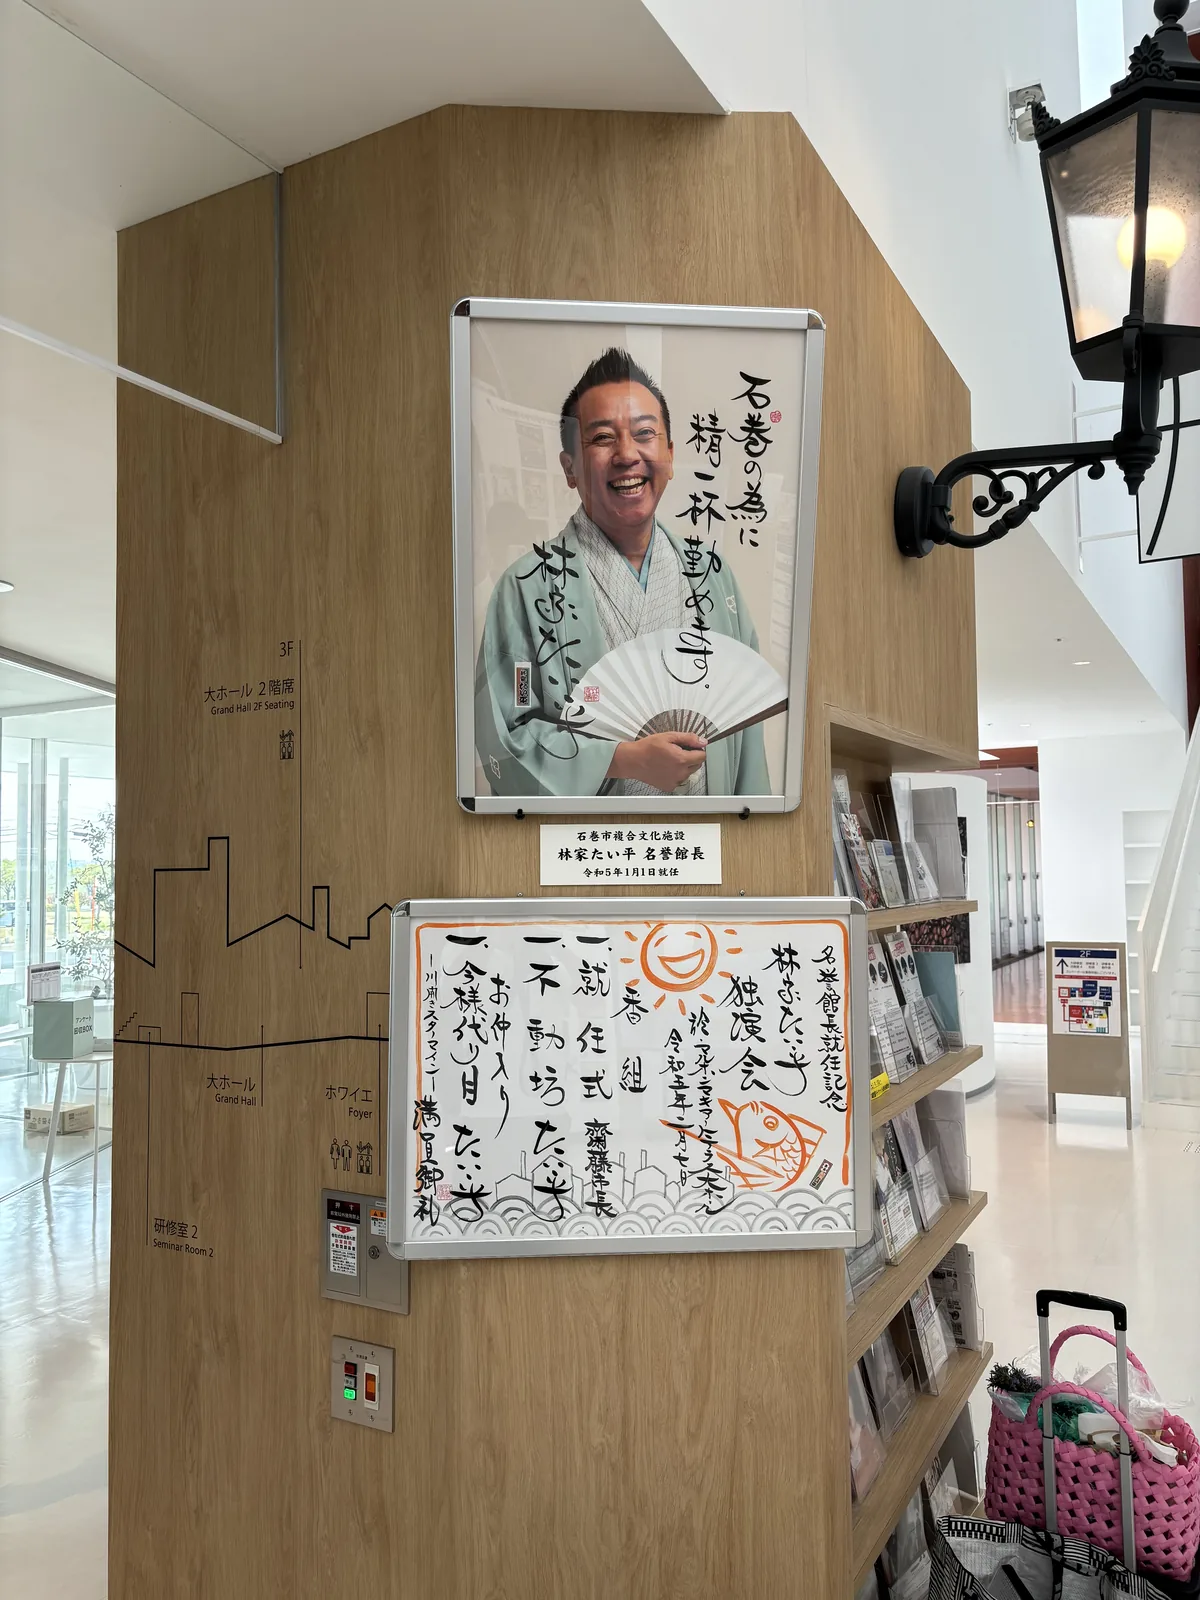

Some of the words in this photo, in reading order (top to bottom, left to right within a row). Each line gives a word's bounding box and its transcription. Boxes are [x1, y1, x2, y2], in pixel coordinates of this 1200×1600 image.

[725, 371, 773, 547] 石巻の為に
[279, 640, 294, 657] 3F
[204, 683, 253, 703] 大ホール
[258, 678, 294, 696] 2階席
[211, 704, 235, 715] Grand
[236, 702, 251, 713] Hall
[253, 702, 263, 711] 2F
[264, 700, 295, 710] Seating
[576, 830, 686, 842] 石巻市複合文化施設
[557, 847, 637, 862] 林家たい平
[643, 846, 705, 861] 名誉館長
[583, 867, 680, 877] 令和5年1月1日就任
[1079, 950, 1092, 958] 2F
[717, 975, 770, 1091] 独演会
[811, 945, 848, 1112] 名誉館長就任記念
[489, 973, 511, 1139] お仲入り
[206, 1073, 256, 1092] 大ホール
[215, 1093, 239, 1105] Grand
[241, 1096, 257, 1106] Hall
[325, 1085, 373, 1103] ホワイエ
[348, 1107, 373, 1120] Foyer
[413, 1095, 444, 1226] 満員御礼
[154, 1217, 189, 1239] 研修室
[191, 1224, 198, 1239] 2
[153, 1238, 183, 1252] Seminar
[185, 1243, 207, 1256] Room
[208, 1247, 214, 1257] 2
